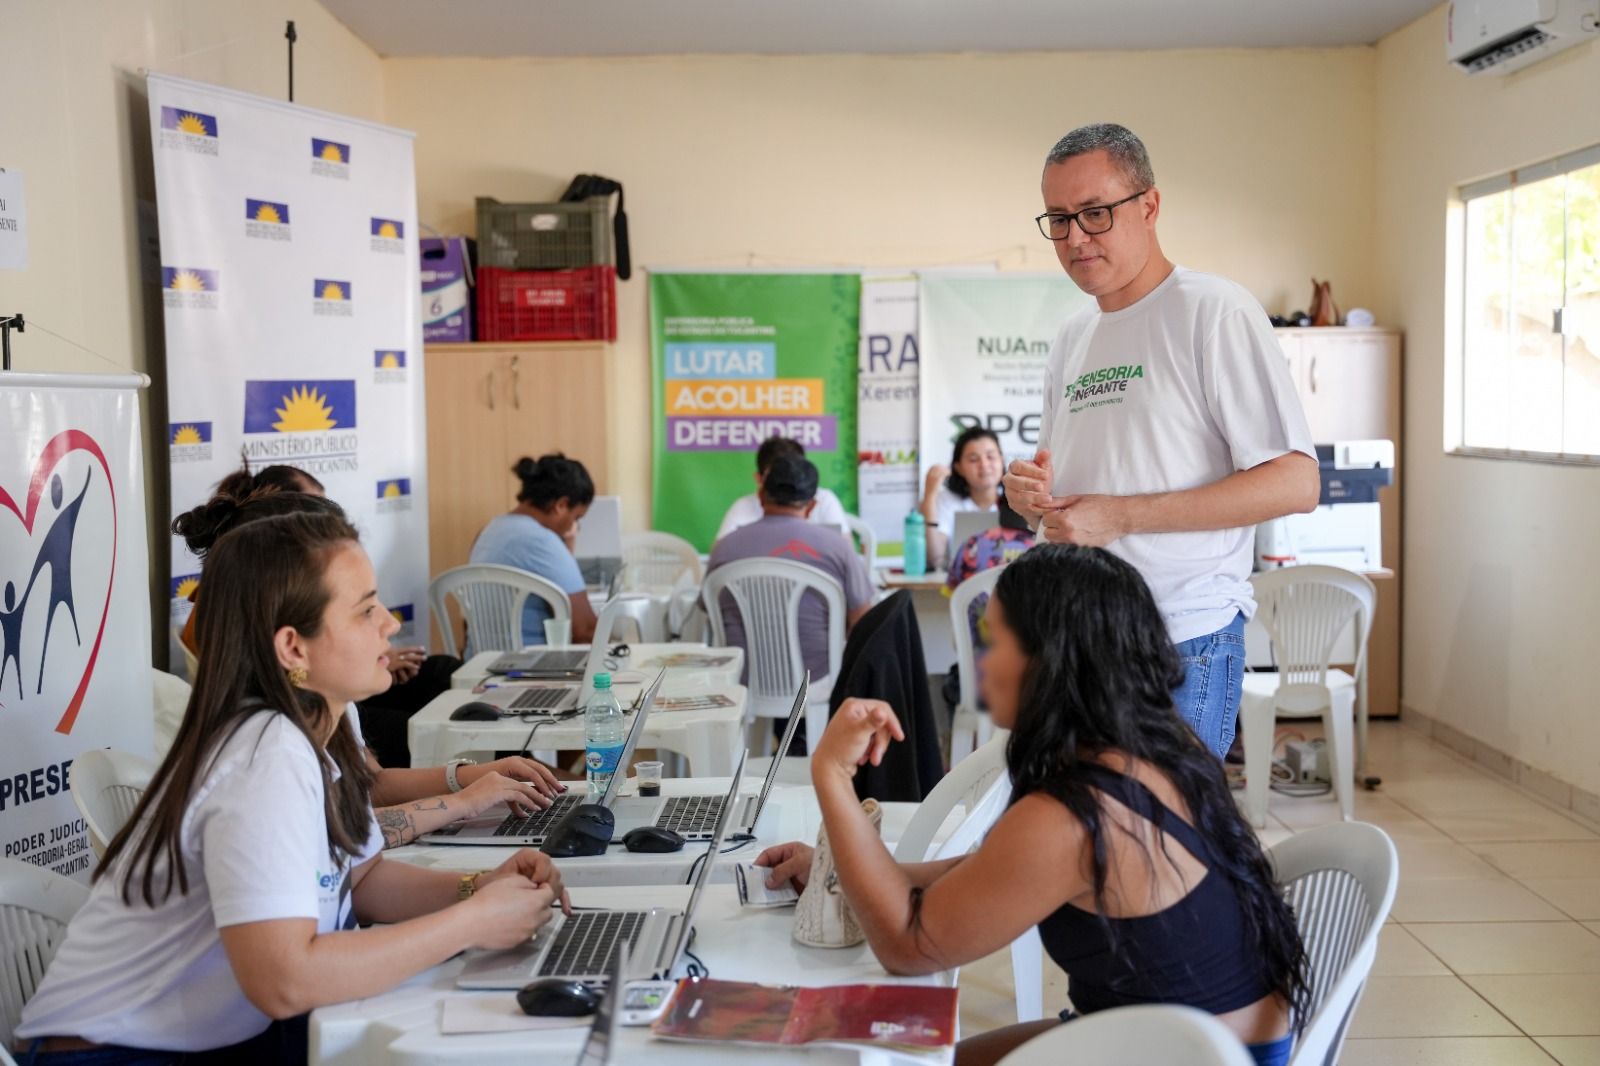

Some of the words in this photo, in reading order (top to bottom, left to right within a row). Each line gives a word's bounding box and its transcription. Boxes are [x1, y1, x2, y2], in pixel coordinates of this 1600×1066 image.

[859, 333, 919, 373] RA
[977, 336, 1053, 354] NUAm
[674, 350, 765, 375] LUTAR
[674, 386, 810, 411] ACOLHER
[242, 435, 312, 457] MINISTÉRIO
[314, 430, 358, 453] PÚBLICO
[674, 420, 822, 446] DEFENDER
[307, 458, 359, 474] TOCANTINS
[0, 759, 73, 812] PRESE
[5, 832, 46, 858] PODER
